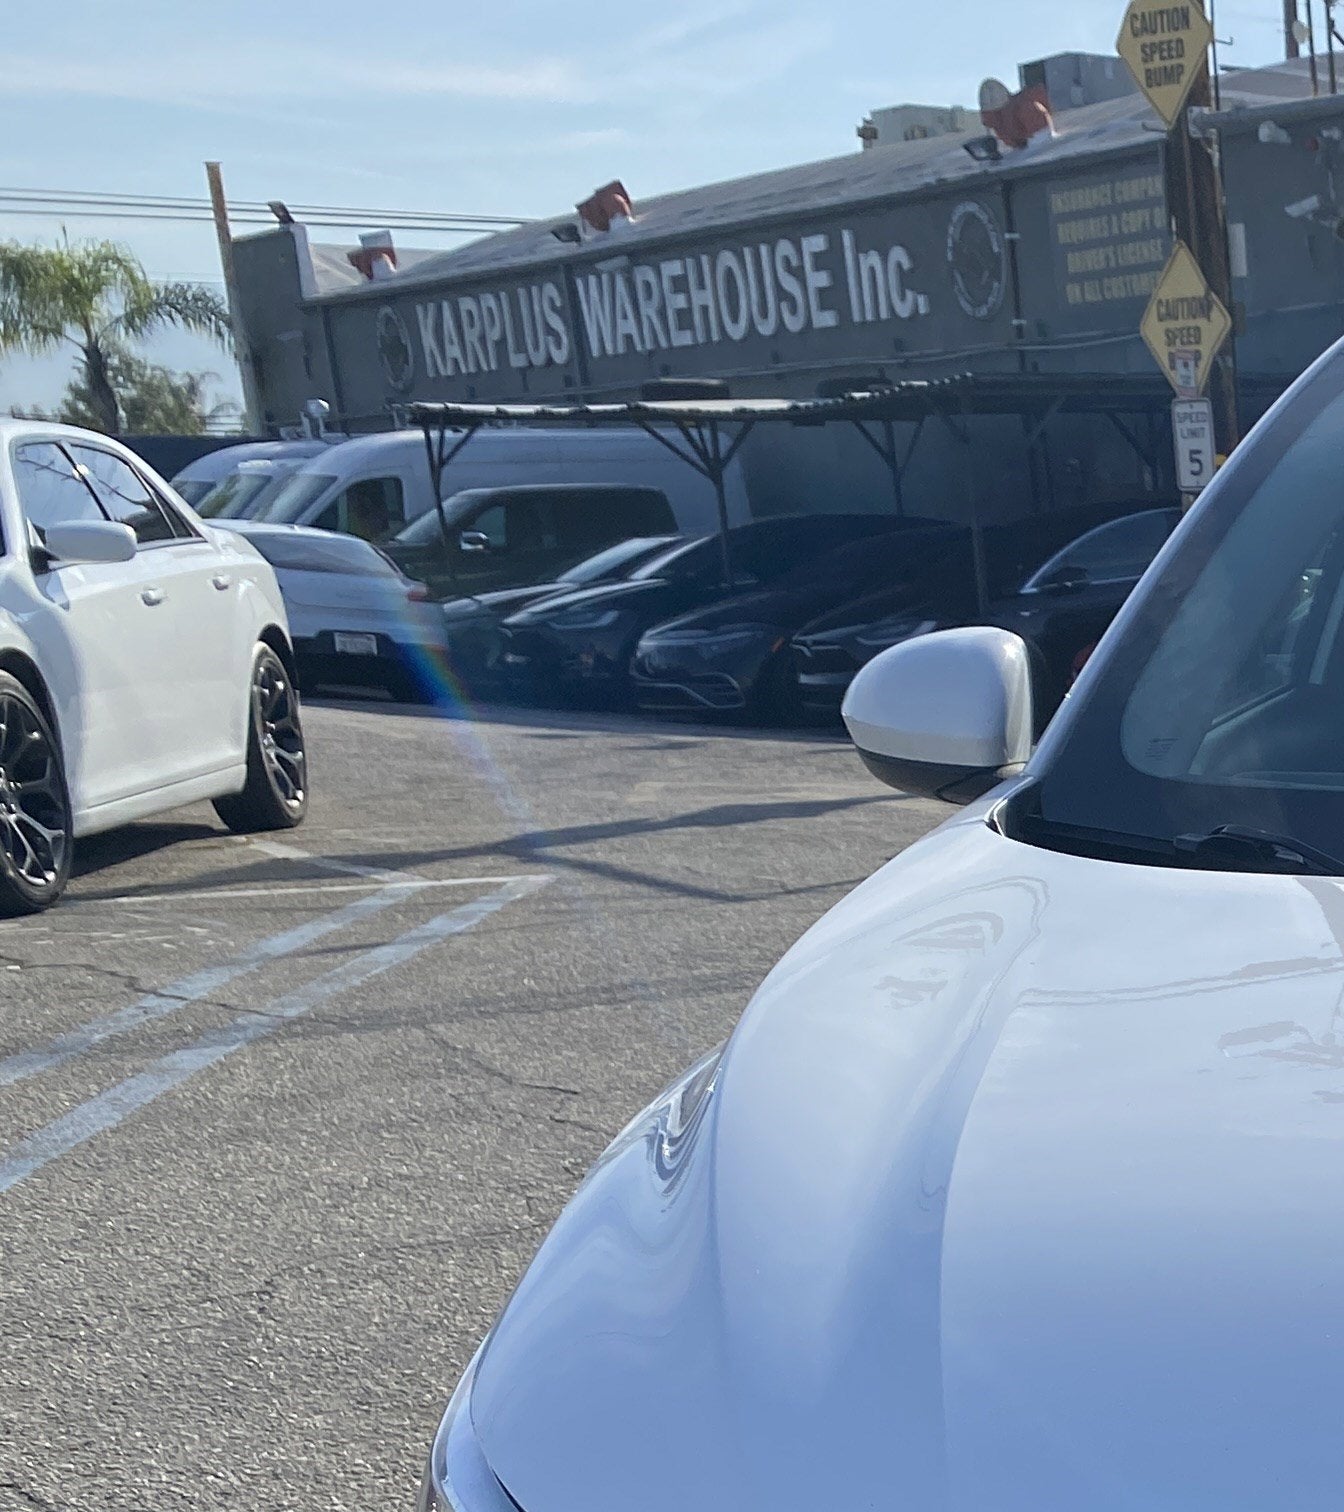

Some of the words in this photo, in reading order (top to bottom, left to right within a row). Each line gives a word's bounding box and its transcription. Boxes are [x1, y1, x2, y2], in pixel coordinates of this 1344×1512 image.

[1130, 6, 1190, 38] CAUTION
[1141, 38, 1185, 63] SPEED
[1145, 63, 1184, 88] BUMP
[415, 282, 569, 378] KARPLUS
[576, 234, 839, 358] WAREHOUSE
[842, 229, 931, 323] Inc.
[1156, 295, 1210, 323] CAUTION
[1164, 325, 1202, 348] SPEED
[1176, 411, 1209, 424] SPEED
[1180, 426, 1206, 439] LIMIT
[1188, 448, 1203, 476] 5
